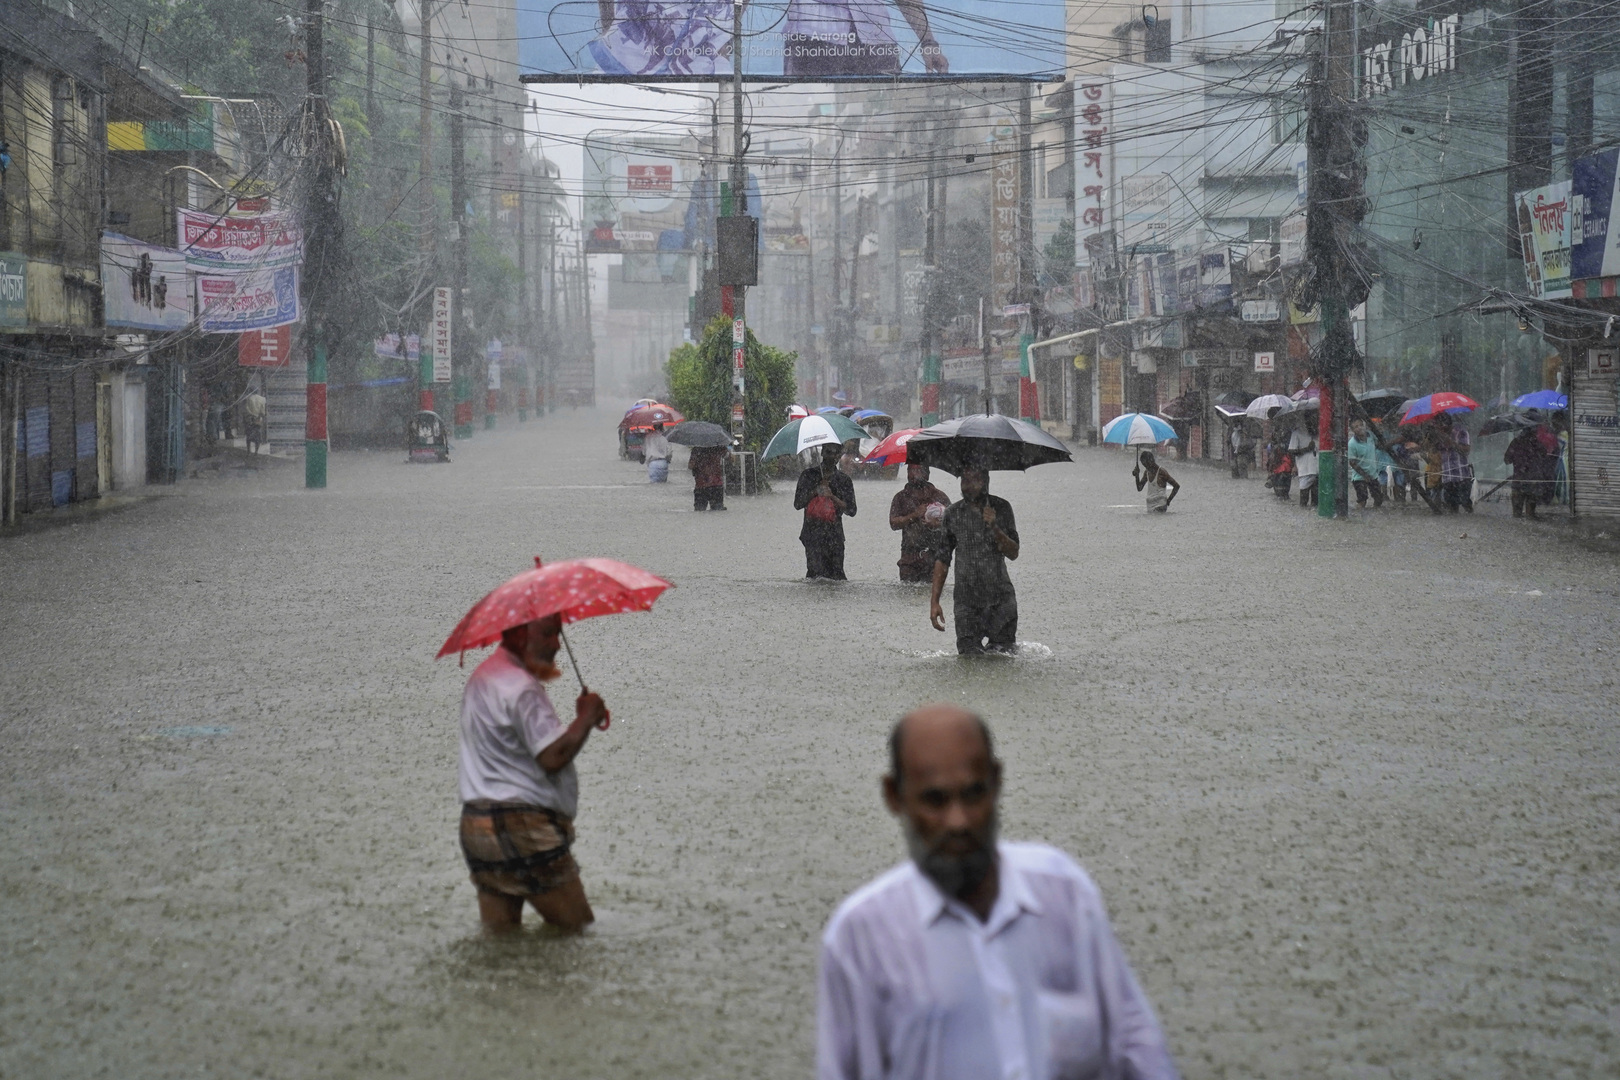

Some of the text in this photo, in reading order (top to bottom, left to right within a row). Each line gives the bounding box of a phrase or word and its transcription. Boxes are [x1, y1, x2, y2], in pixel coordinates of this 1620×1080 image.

[772, 31, 807, 42] inside
[810, 31, 856, 43] Aarong
[643, 45, 660, 56] AK
[663, 45, 722, 58] Complex,
[751, 45, 791, 56] Shahid
[795, 44, 865, 56] Shahidullah
[908, 45, 941, 56] Road
